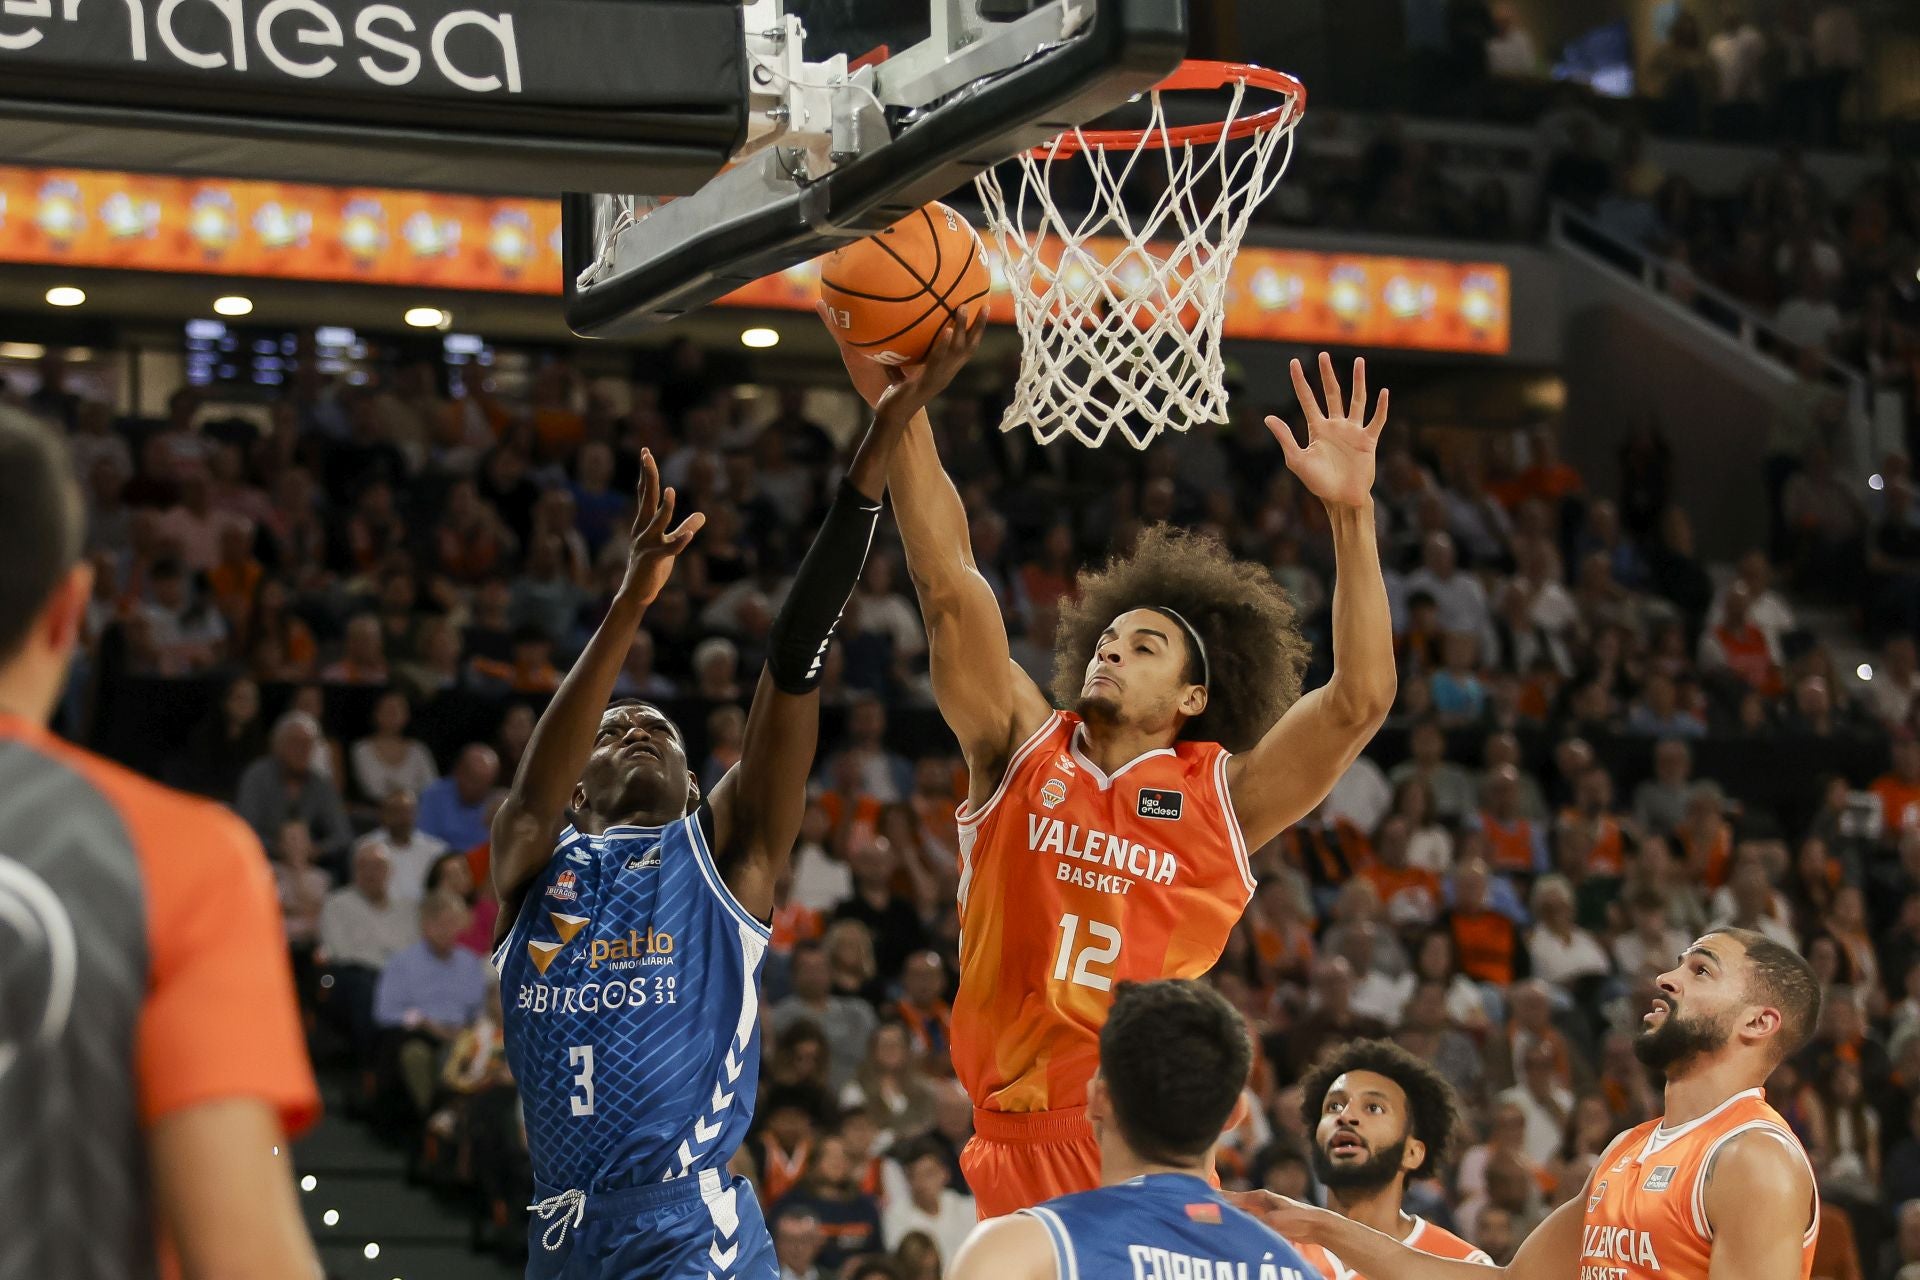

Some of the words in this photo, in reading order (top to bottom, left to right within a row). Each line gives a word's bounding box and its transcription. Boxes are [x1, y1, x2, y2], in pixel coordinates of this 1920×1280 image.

[1142, 797, 1159, 806] liga
[1141, 806, 1178, 817] endesa
[1028, 813, 1177, 886] VALENCIA
[1056, 862, 1135, 895] BASKET
[548, 887, 577, 899] BURGOS
[1053, 912, 1122, 992] 12
[609, 956, 674, 971] INMOLIARIA
[655, 976, 676, 989] 20
[655, 991, 677, 1004] 31
[569, 1044, 595, 1117] 3
[1580, 1224, 1661, 1270] ALENCIA
